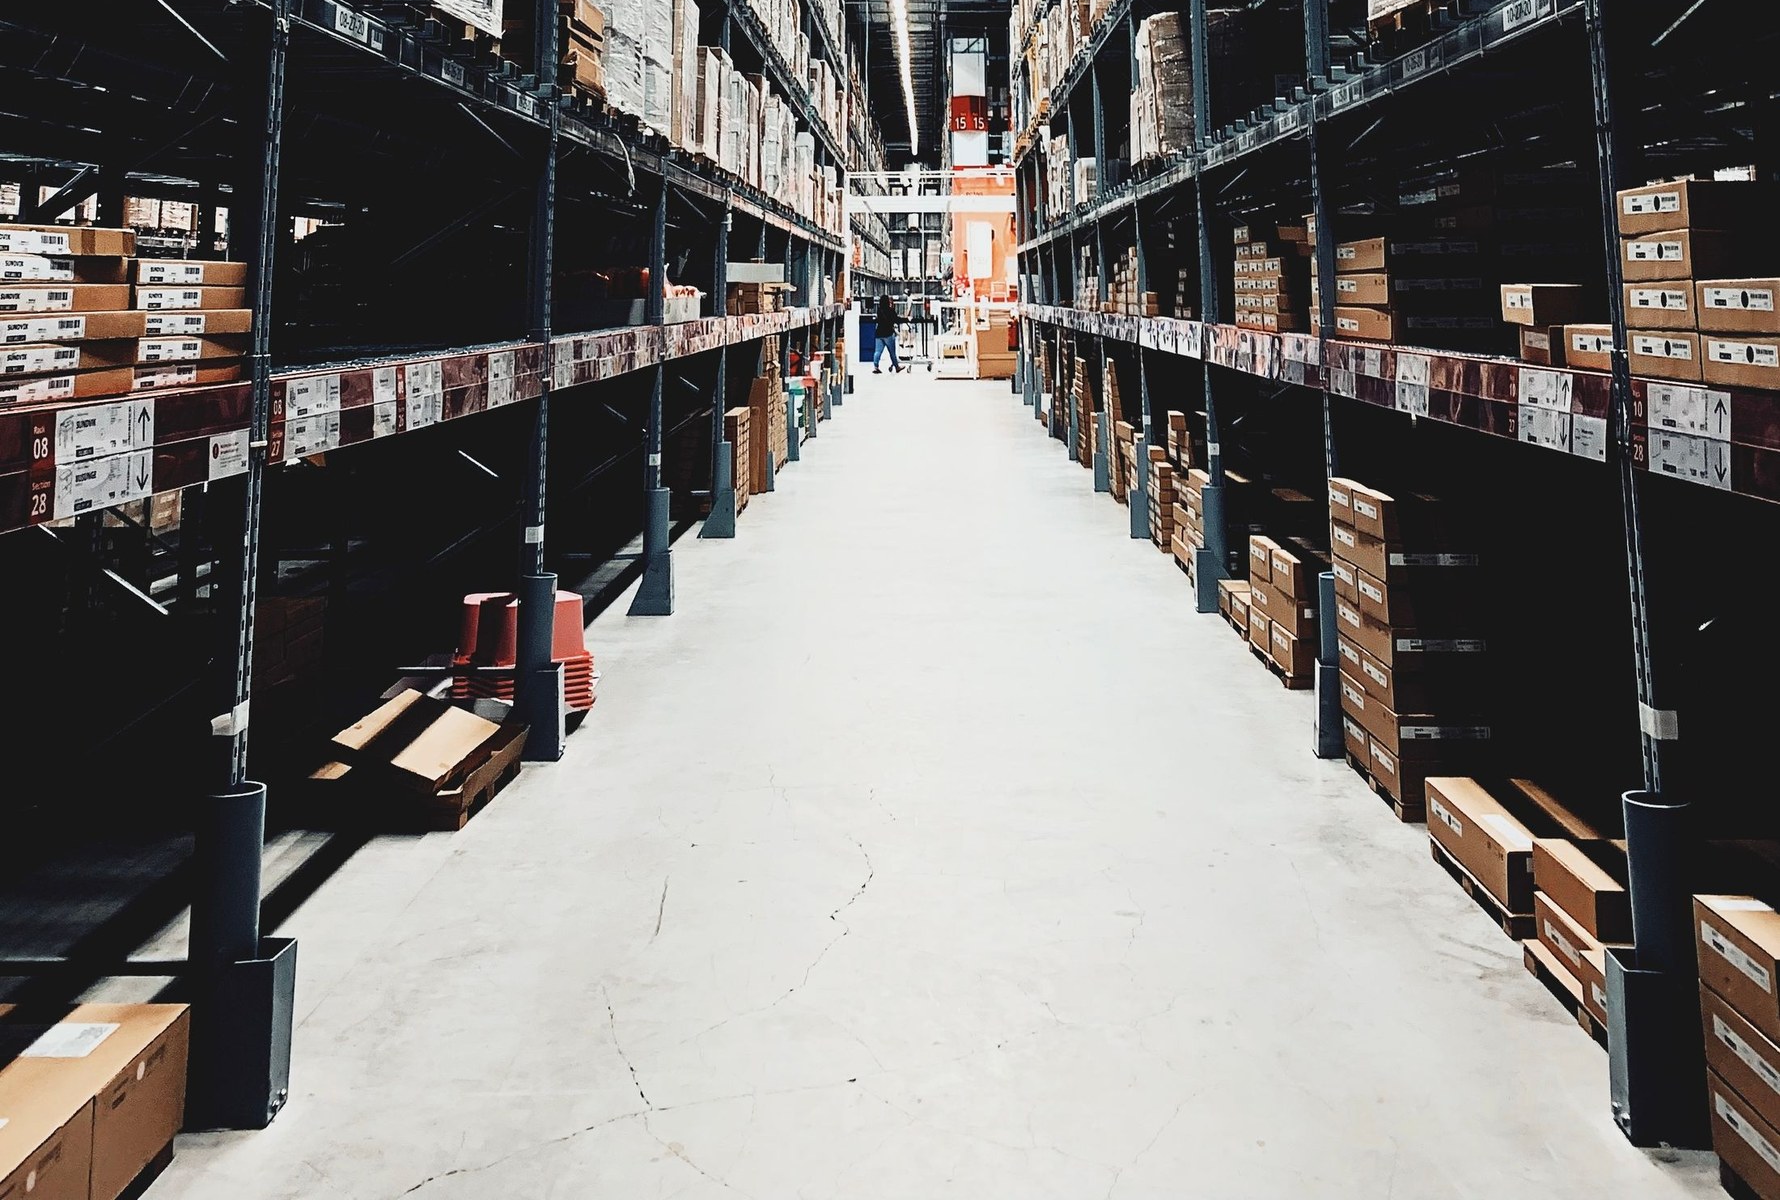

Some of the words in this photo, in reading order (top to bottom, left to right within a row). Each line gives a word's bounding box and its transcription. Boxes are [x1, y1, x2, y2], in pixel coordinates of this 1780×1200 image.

[1506, 0, 1532, 24] 10-27-20
[954, 116, 966, 130] 15
[973, 116, 985, 130] 15
[273, 399, 283, 416] 08
[1633, 400, 1643, 418] 10
[33, 425, 46, 435] Rack
[33, 437, 49, 460] 08
[271, 440, 281, 457] 27
[1633, 443, 1644, 462] 28
[31, 481, 51, 491] Section
[31, 493, 47, 517] 28
